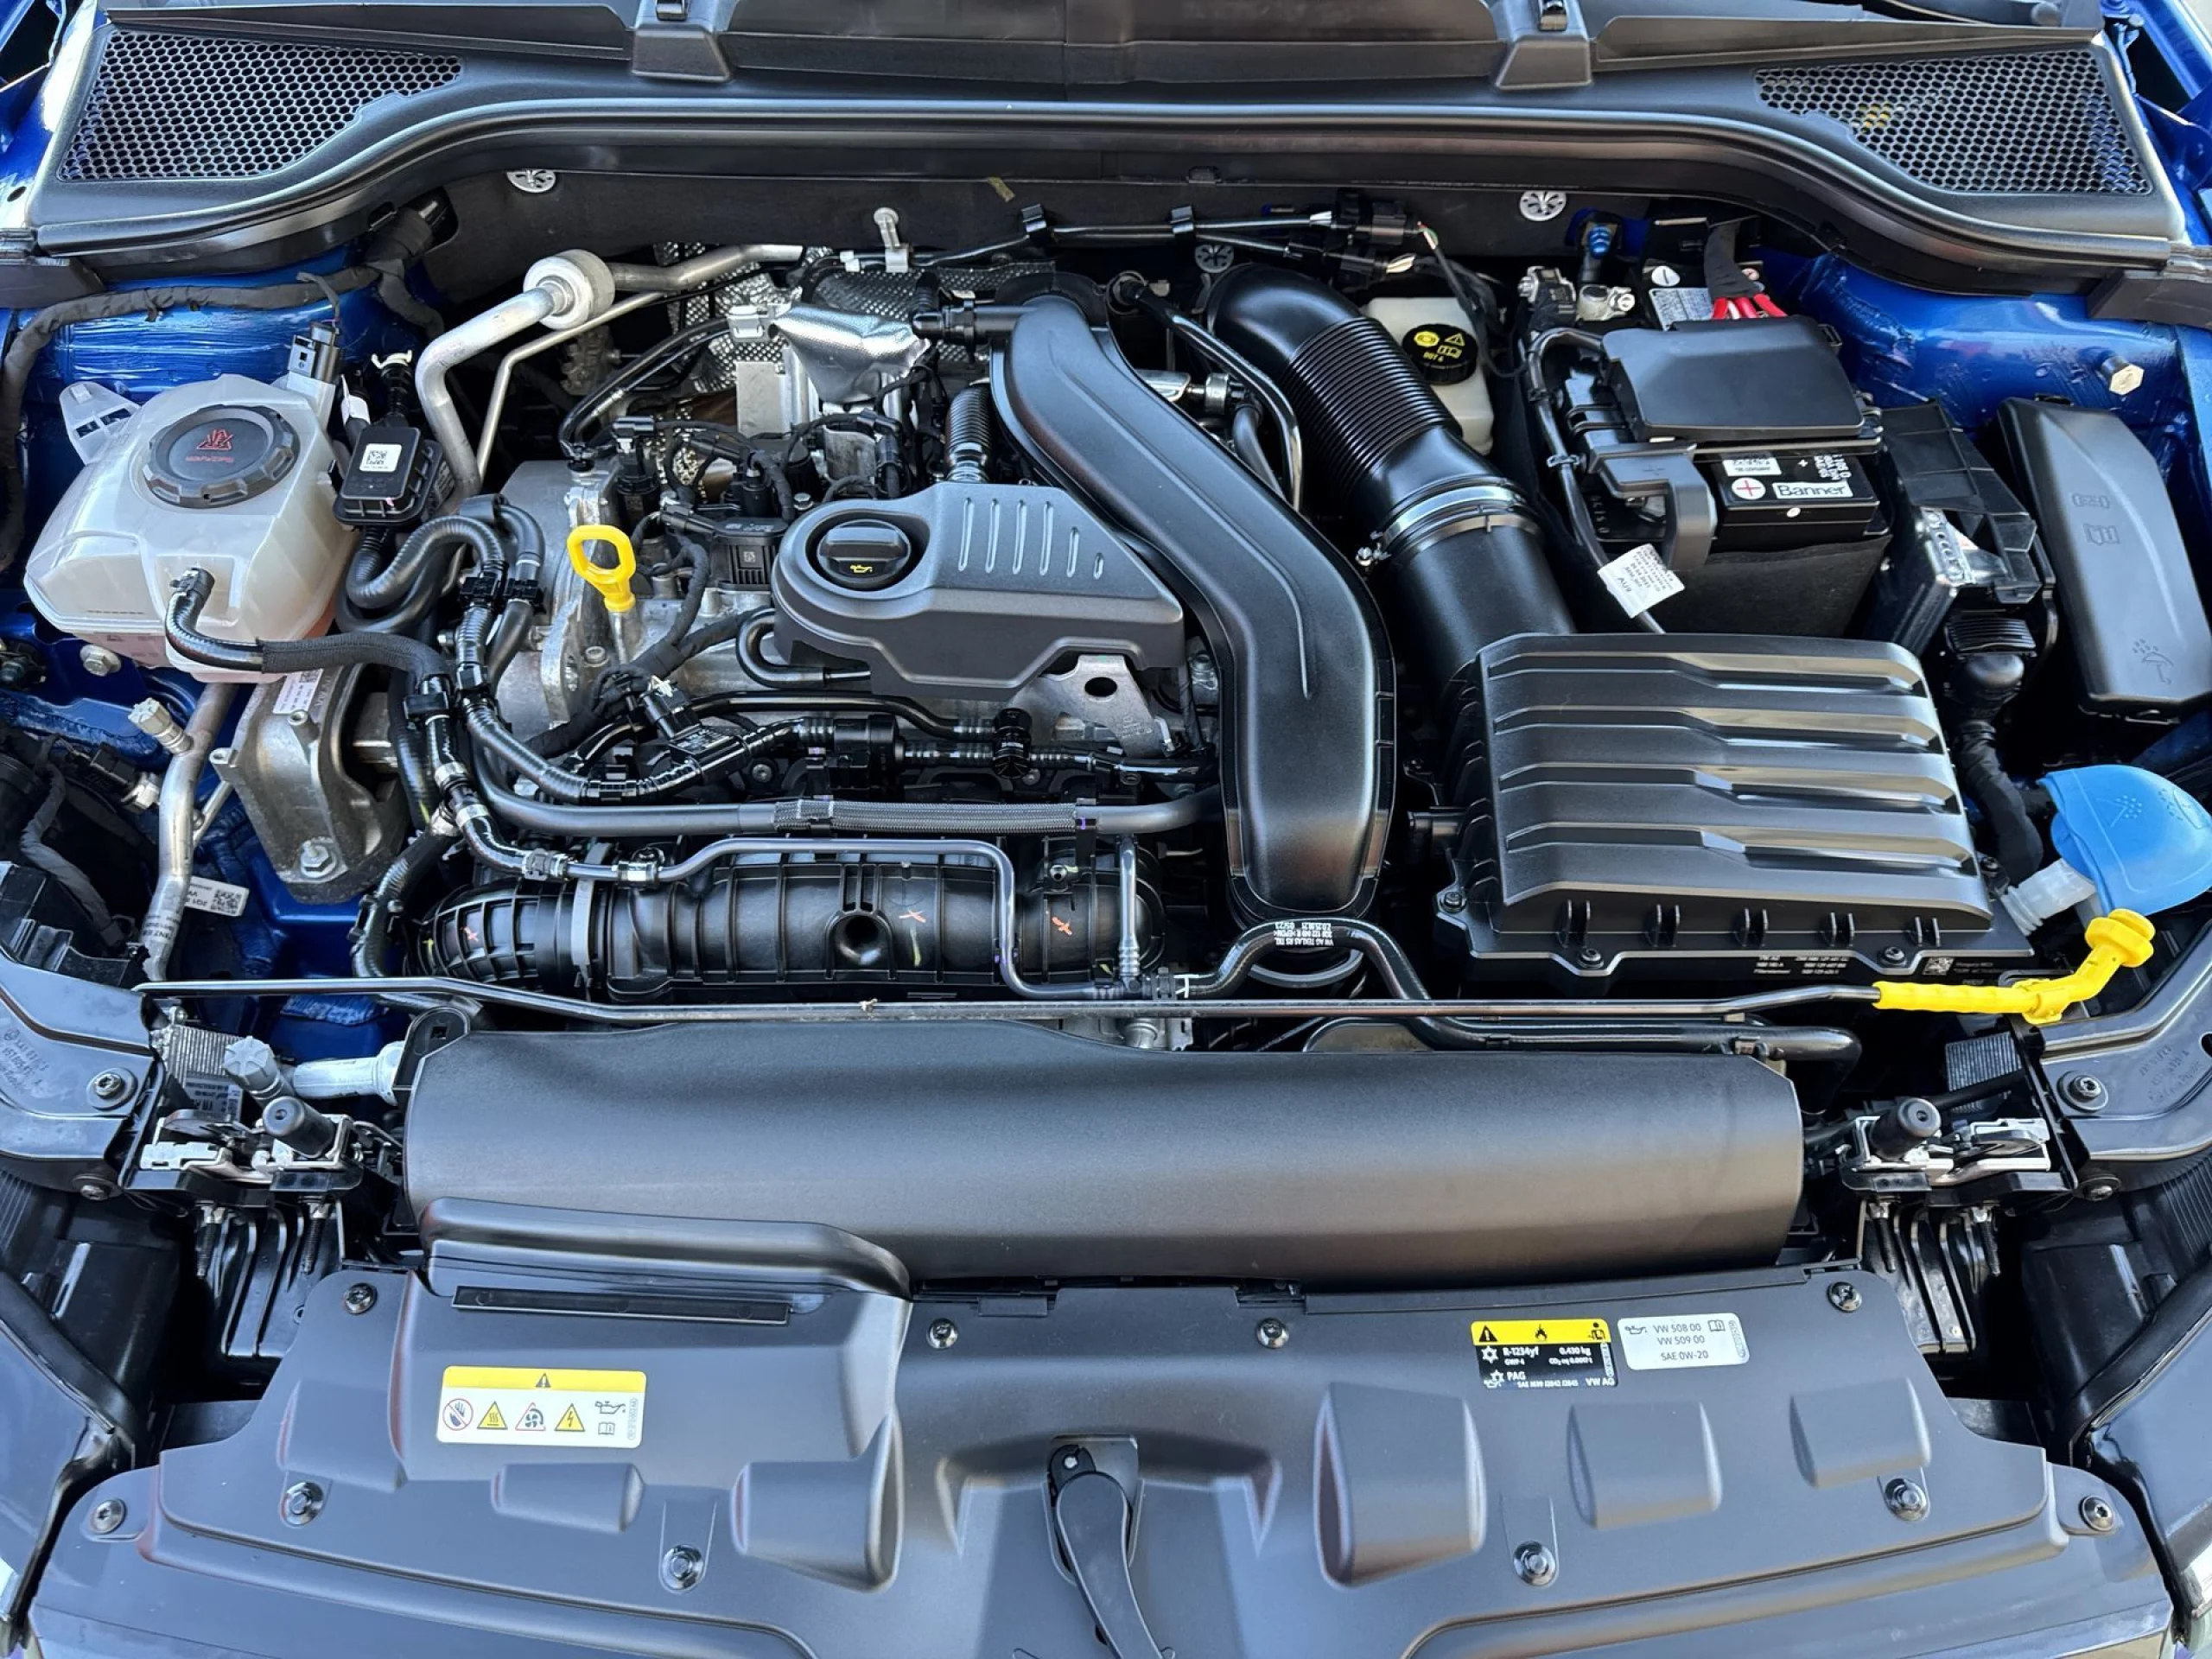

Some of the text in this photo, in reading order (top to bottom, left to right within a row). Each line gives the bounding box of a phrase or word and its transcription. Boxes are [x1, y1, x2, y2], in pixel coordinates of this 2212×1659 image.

[1777, 484, 1846, 496] Banner
[1652, 1323, 1701, 1333] VW 508 00
[1656, 1335, 1705, 1345] VW 509 00
[1503, 1345, 1538, 1358] R-1234yf
[1580, 1346, 1592, 1357] kg
[1661, 1350, 1709, 1361] SAE 0W-20
[1506, 1371, 1526, 1381] PAG
[1585, 1377, 1615, 1386] VW AG
